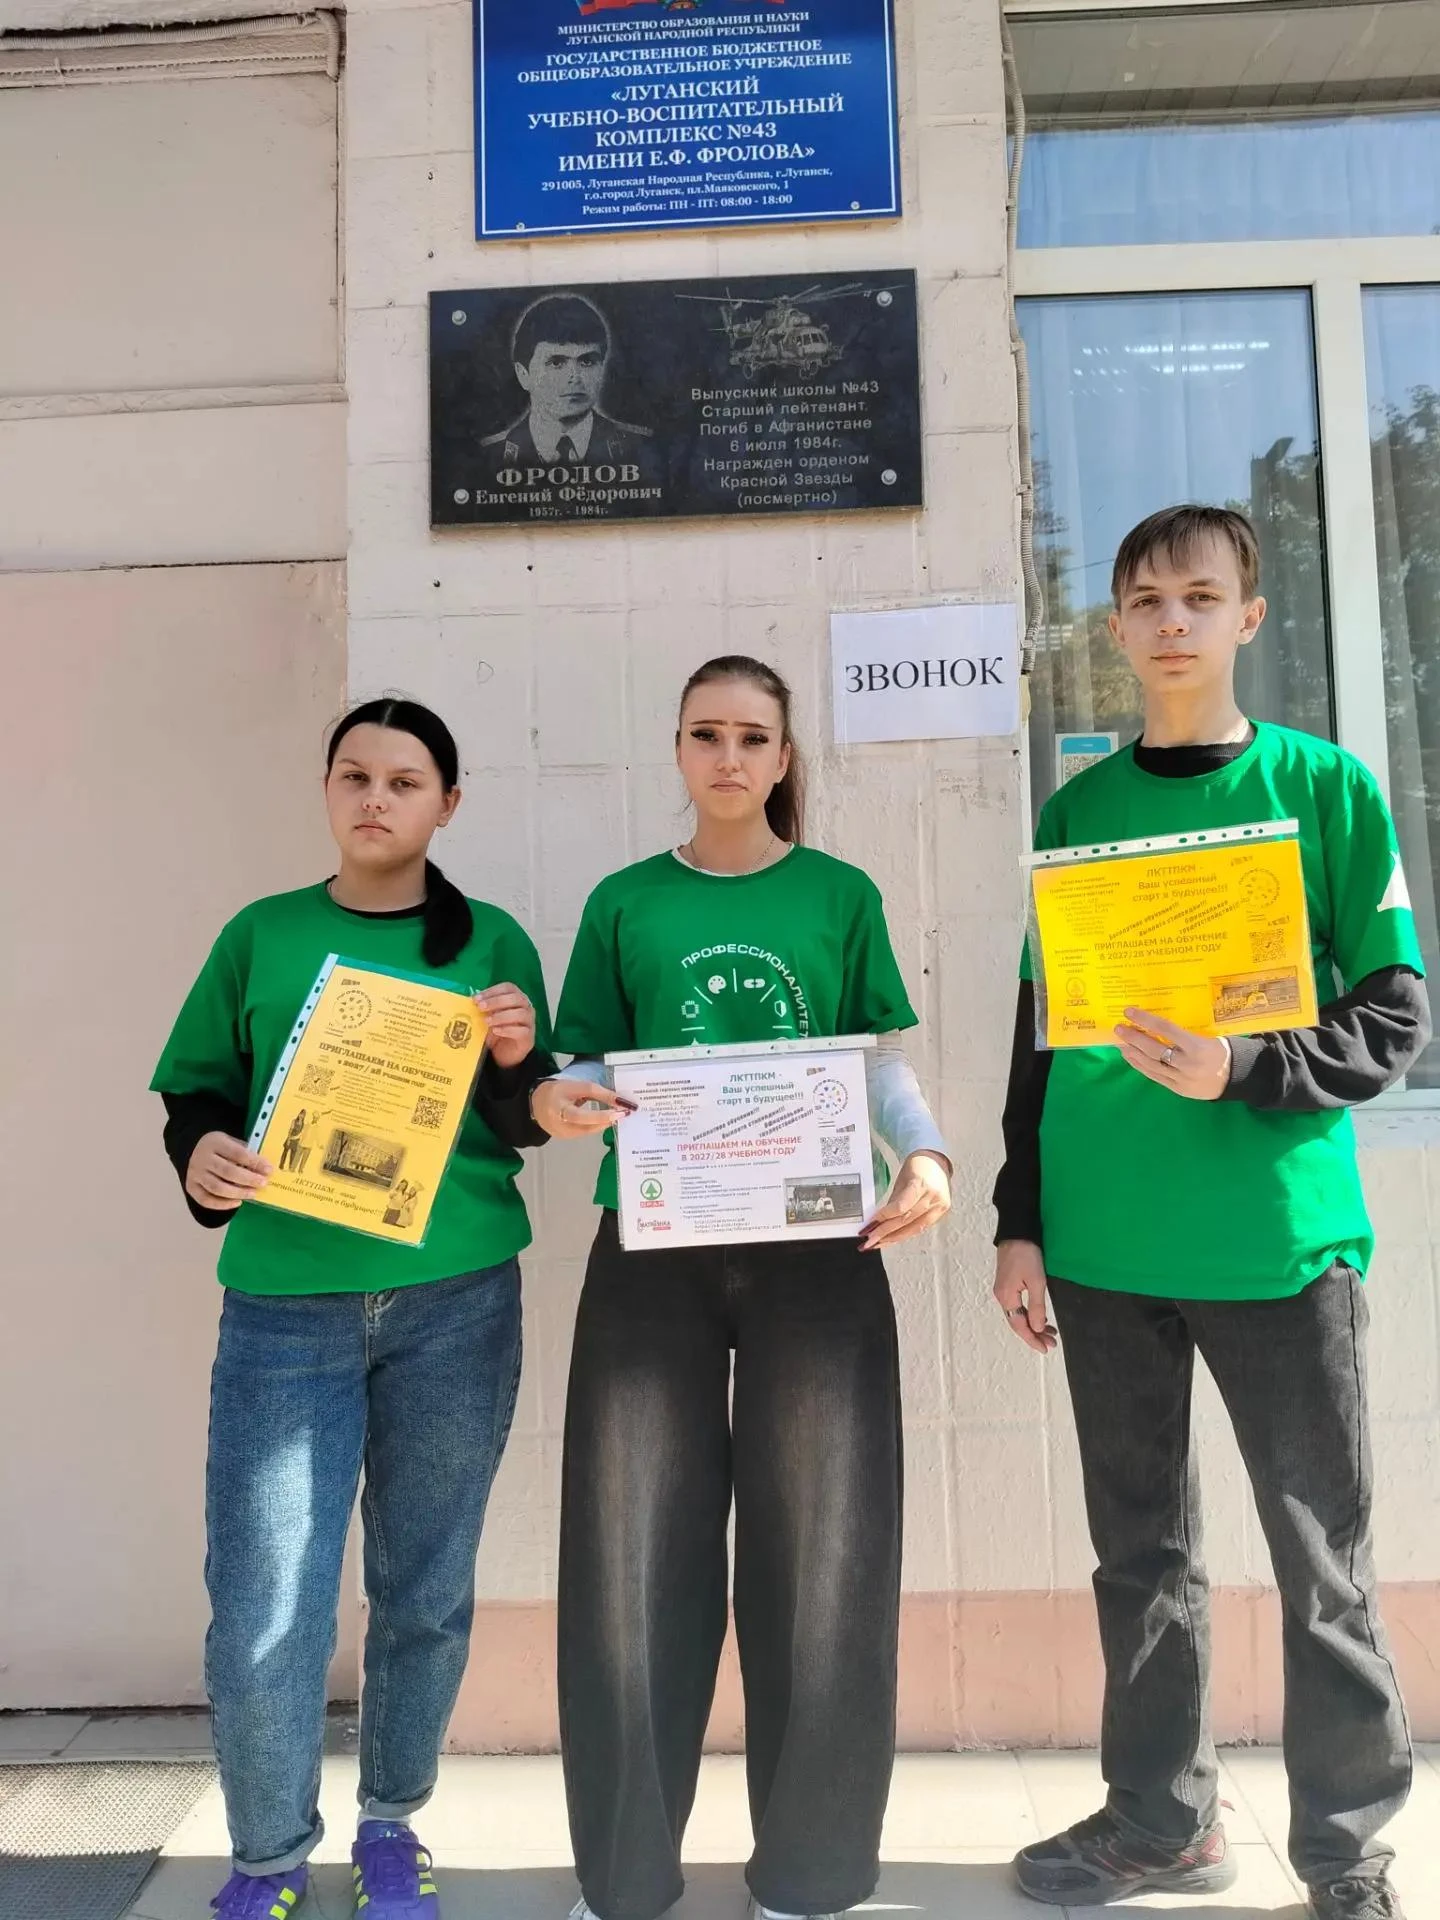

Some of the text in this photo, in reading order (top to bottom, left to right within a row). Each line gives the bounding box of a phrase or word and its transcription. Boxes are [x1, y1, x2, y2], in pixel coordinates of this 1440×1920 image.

[558, 22, 658, 35] МИНИСТЕРСТВО
[660, 17, 750, 29] ОБРАЗОВАНИЯ
[766, 12, 809, 22] НАУКИ
[566, 24, 800, 45] ЛУГАНСКОЙ НАРОДНОЙ РЕСПУБЛИКИ
[546, 39, 822, 66] ГОСУДАРСТВЕННОЕ БЮДЖЕТНОЕ
[518, 53, 851, 83] ОБЩЕОБРАЗОВАТЕЛЬНОЕ УЧРЕЖДЕНИЕ
[611, 77, 759, 101] «ЛУГАНСКИЙ
[528, 94, 844, 129] УЧЕБНО-ВОСПИТАТЕЛЬНЫЙ
[595, 123, 777, 147] КОМПЛЕКС №43
[559, 145, 815, 172] ИМЕНИ Е.Ф. ФРОЛОВА»
[542, 166, 833, 191] 291005, Луганская Народная Республика, г.Луганск,
[584, 180, 789, 201] г.о.город Луганск, пл.Маяковского, 1
[583, 204, 623, 216] Режим
[625, 202, 667, 215] работы:
[669, 200, 689, 211] ПН
[699, 198, 718, 209] ПТ:
[721, 196, 753, 208] 08:00
[762, 194, 792, 206] 18:00
[691, 381, 879, 402] Выпускник школы №43
[702, 402, 774, 418] Старший
[700, 416, 872, 436] Погиб в Афганистане
[730, 434, 841, 452] 6 июля 1984г.
[704, 453, 869, 473] Награжден орденом
[496, 464, 641, 488] ФРОЛОВ
[720, 471, 853, 489] Красной Звезды
[475, 485, 662, 505] Евгений Фёдорович
[737, 490, 838, 507] (посмертно)
[845, 656, 1005, 693] ЗВОНОК
[1138, 874, 1217, 890] Ваш успешный
[1132, 891, 1160, 903] старт
[1094, 932, 1228, 951] ПРИГЛАШАЕМ НА ОБУЧЕНИЕ
[1146, 944, 1193, 958] УЧЕБНОМ
[1196, 942, 1222, 955] ГОДУ
[320, 1042, 385, 1066] ПРИГЛАШАЕМ
[386, 1059, 400, 1070] НА
[402, 1066, 453, 1086] ОБУЧЕНИЕ
[730, 1071, 776, 1083] ЛКТТПКМ
[722, 1081, 794, 1094] Ваш успешный
[717, 1096, 743, 1106] старт
[754, 1092, 804, 1106] будущее!!!
[677, 1135, 802, 1152] ПРИГЛАШАЕМ НА ОБУЧЕНИЕ
[690, 1151, 726, 1161] 2027/28
[728, 1149, 770, 1159] УЧЕБНОМ
[773, 1146, 796, 1157] ГОДУ
